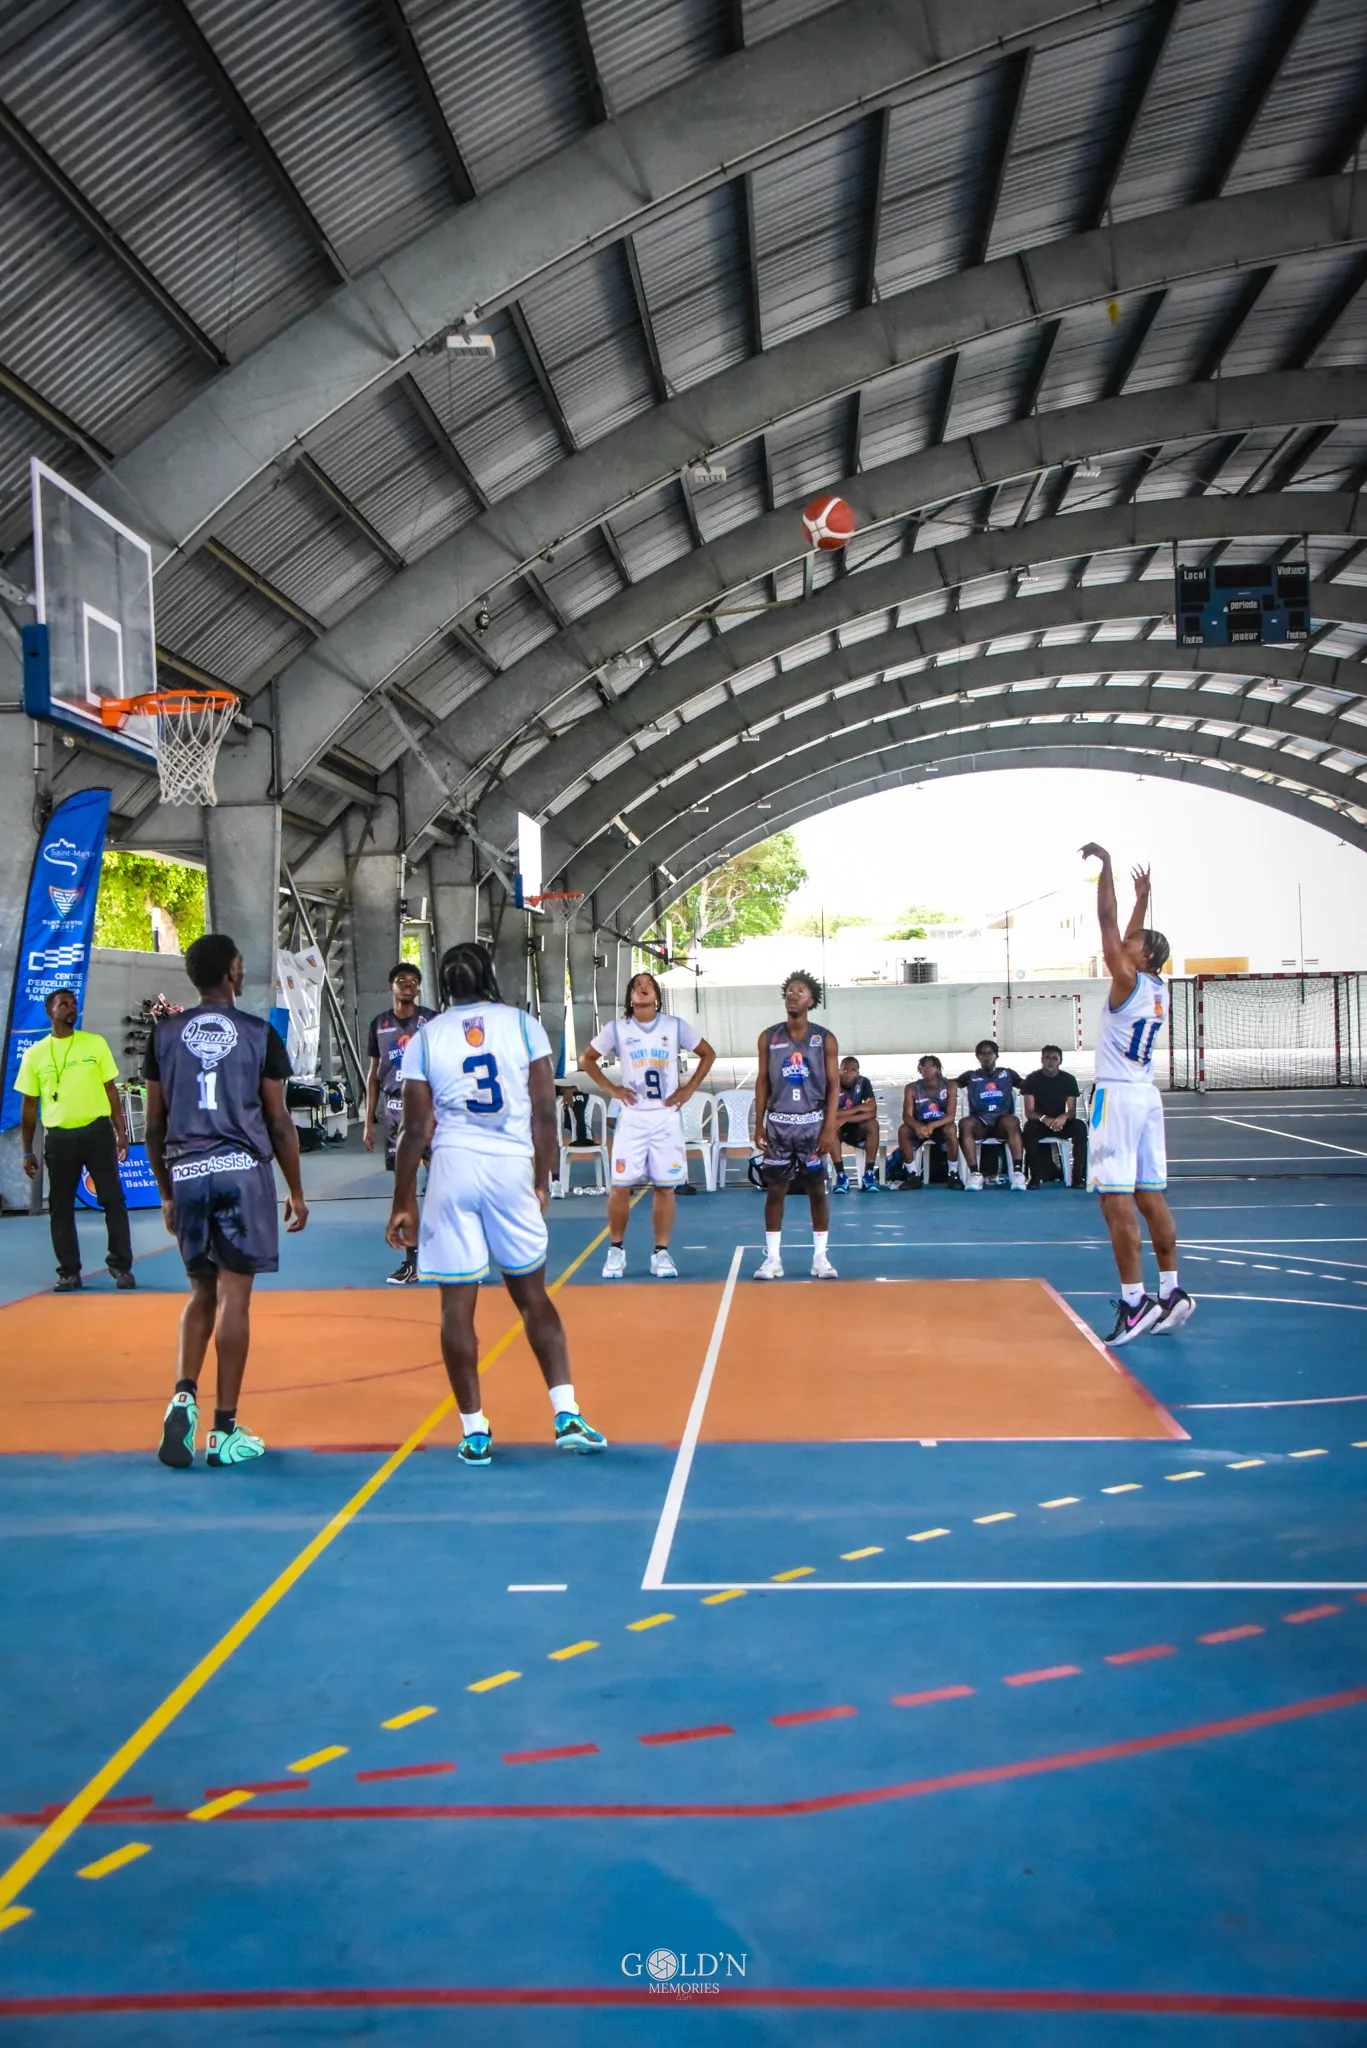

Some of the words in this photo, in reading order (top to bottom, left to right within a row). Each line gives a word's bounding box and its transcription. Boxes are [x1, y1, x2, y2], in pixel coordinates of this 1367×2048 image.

[1183, 569, 1206, 580] Local
[1232, 631, 1258, 642] joueur
[27, 979, 83, 987] D'EXCELLENCE
[183, 1022, 238, 1046] Omar's
[461, 1051, 504, 1114] 3
[645, 1069, 662, 1099] 9
[792, 1089, 801, 1101] 6
